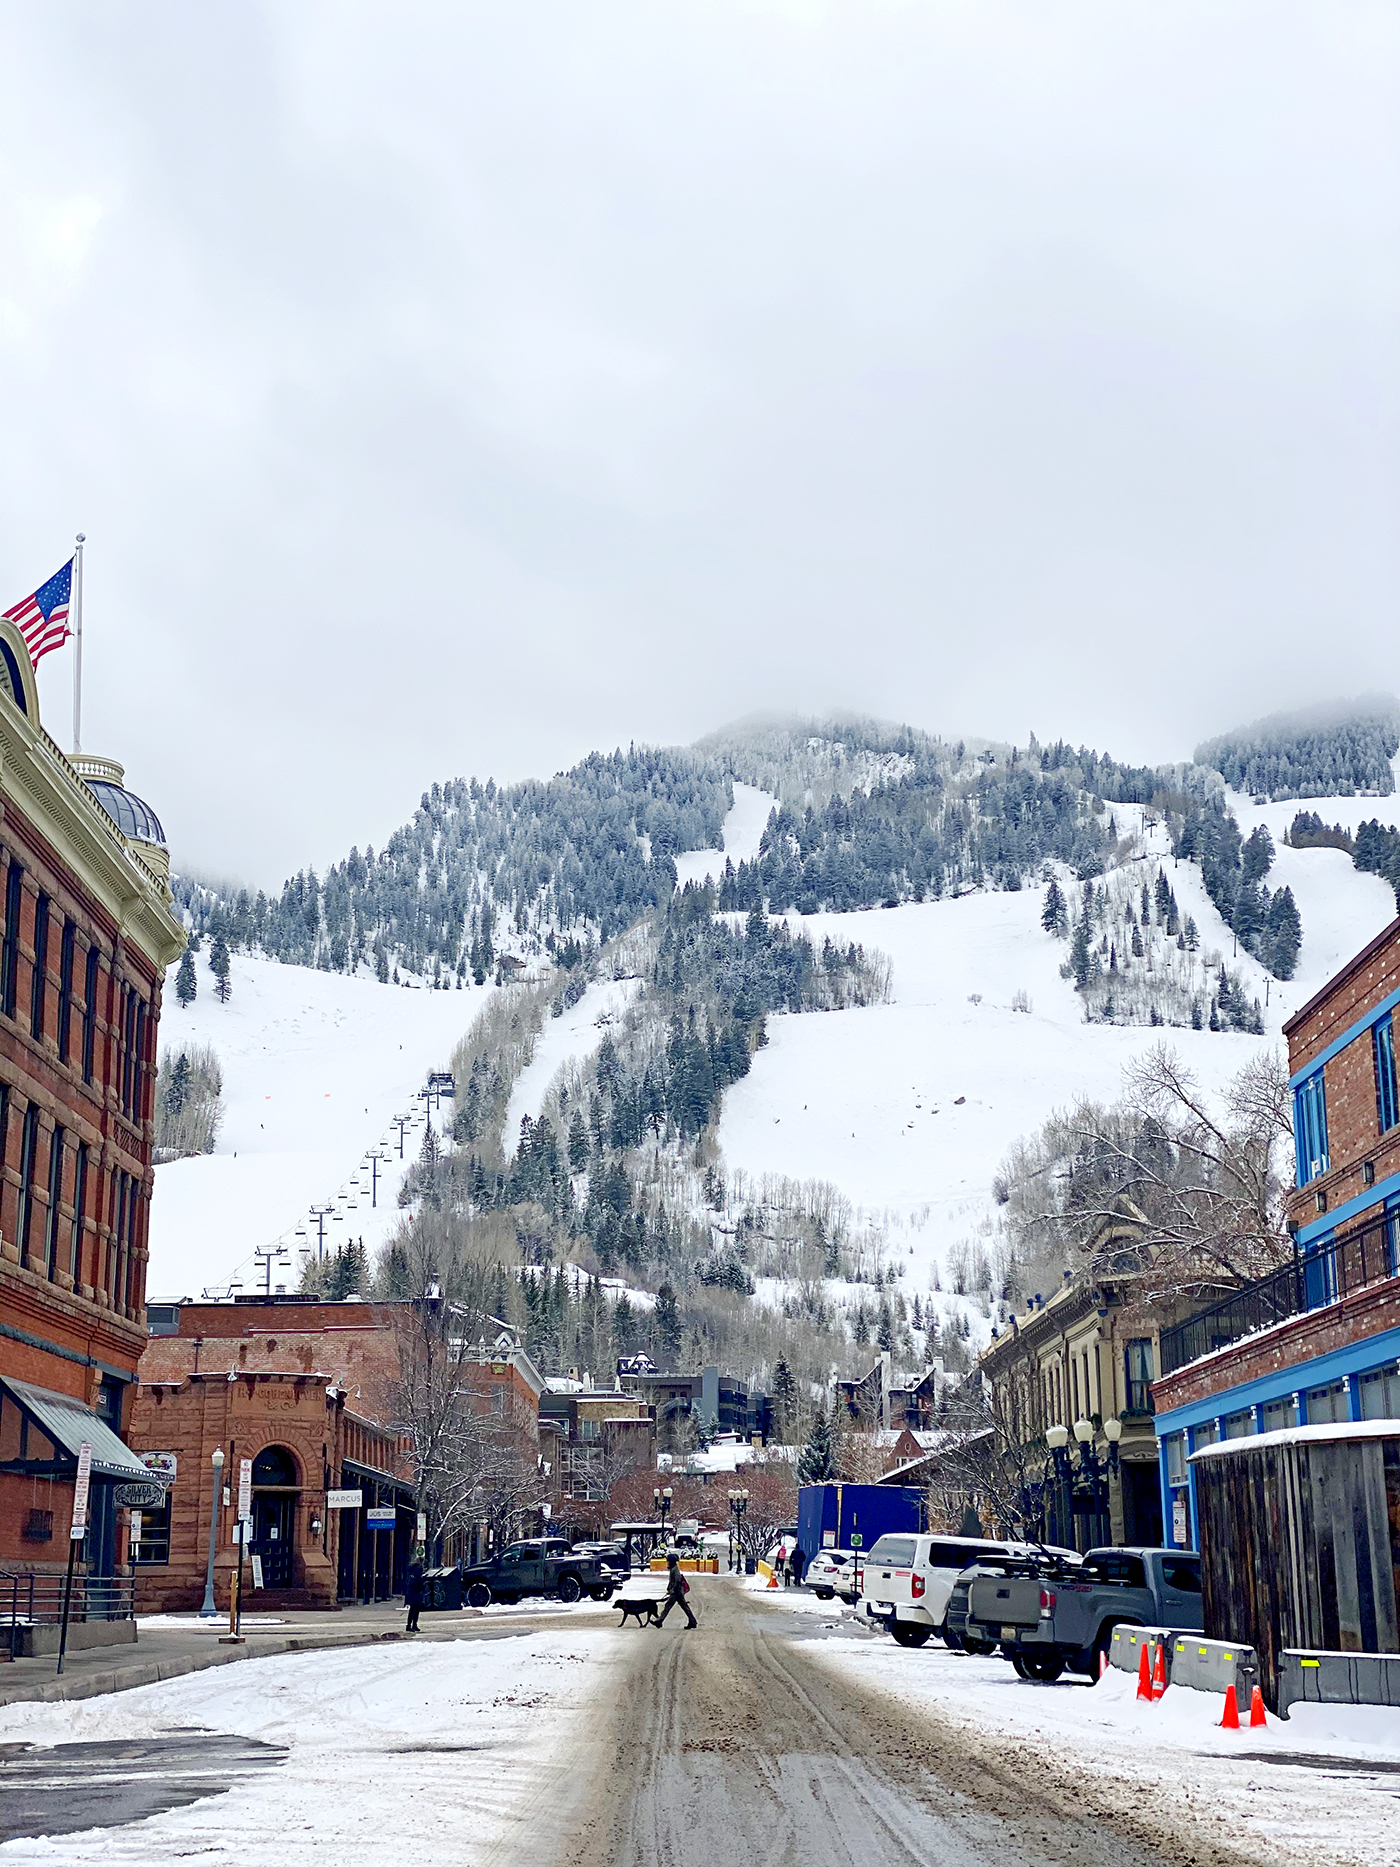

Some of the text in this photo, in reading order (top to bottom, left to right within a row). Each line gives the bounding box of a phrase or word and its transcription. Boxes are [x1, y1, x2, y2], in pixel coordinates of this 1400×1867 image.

[126, 1484, 152, 1494] SILVER
[129, 1494, 148, 1503] CITY
[328, 1495, 362, 1503] MARCUS
